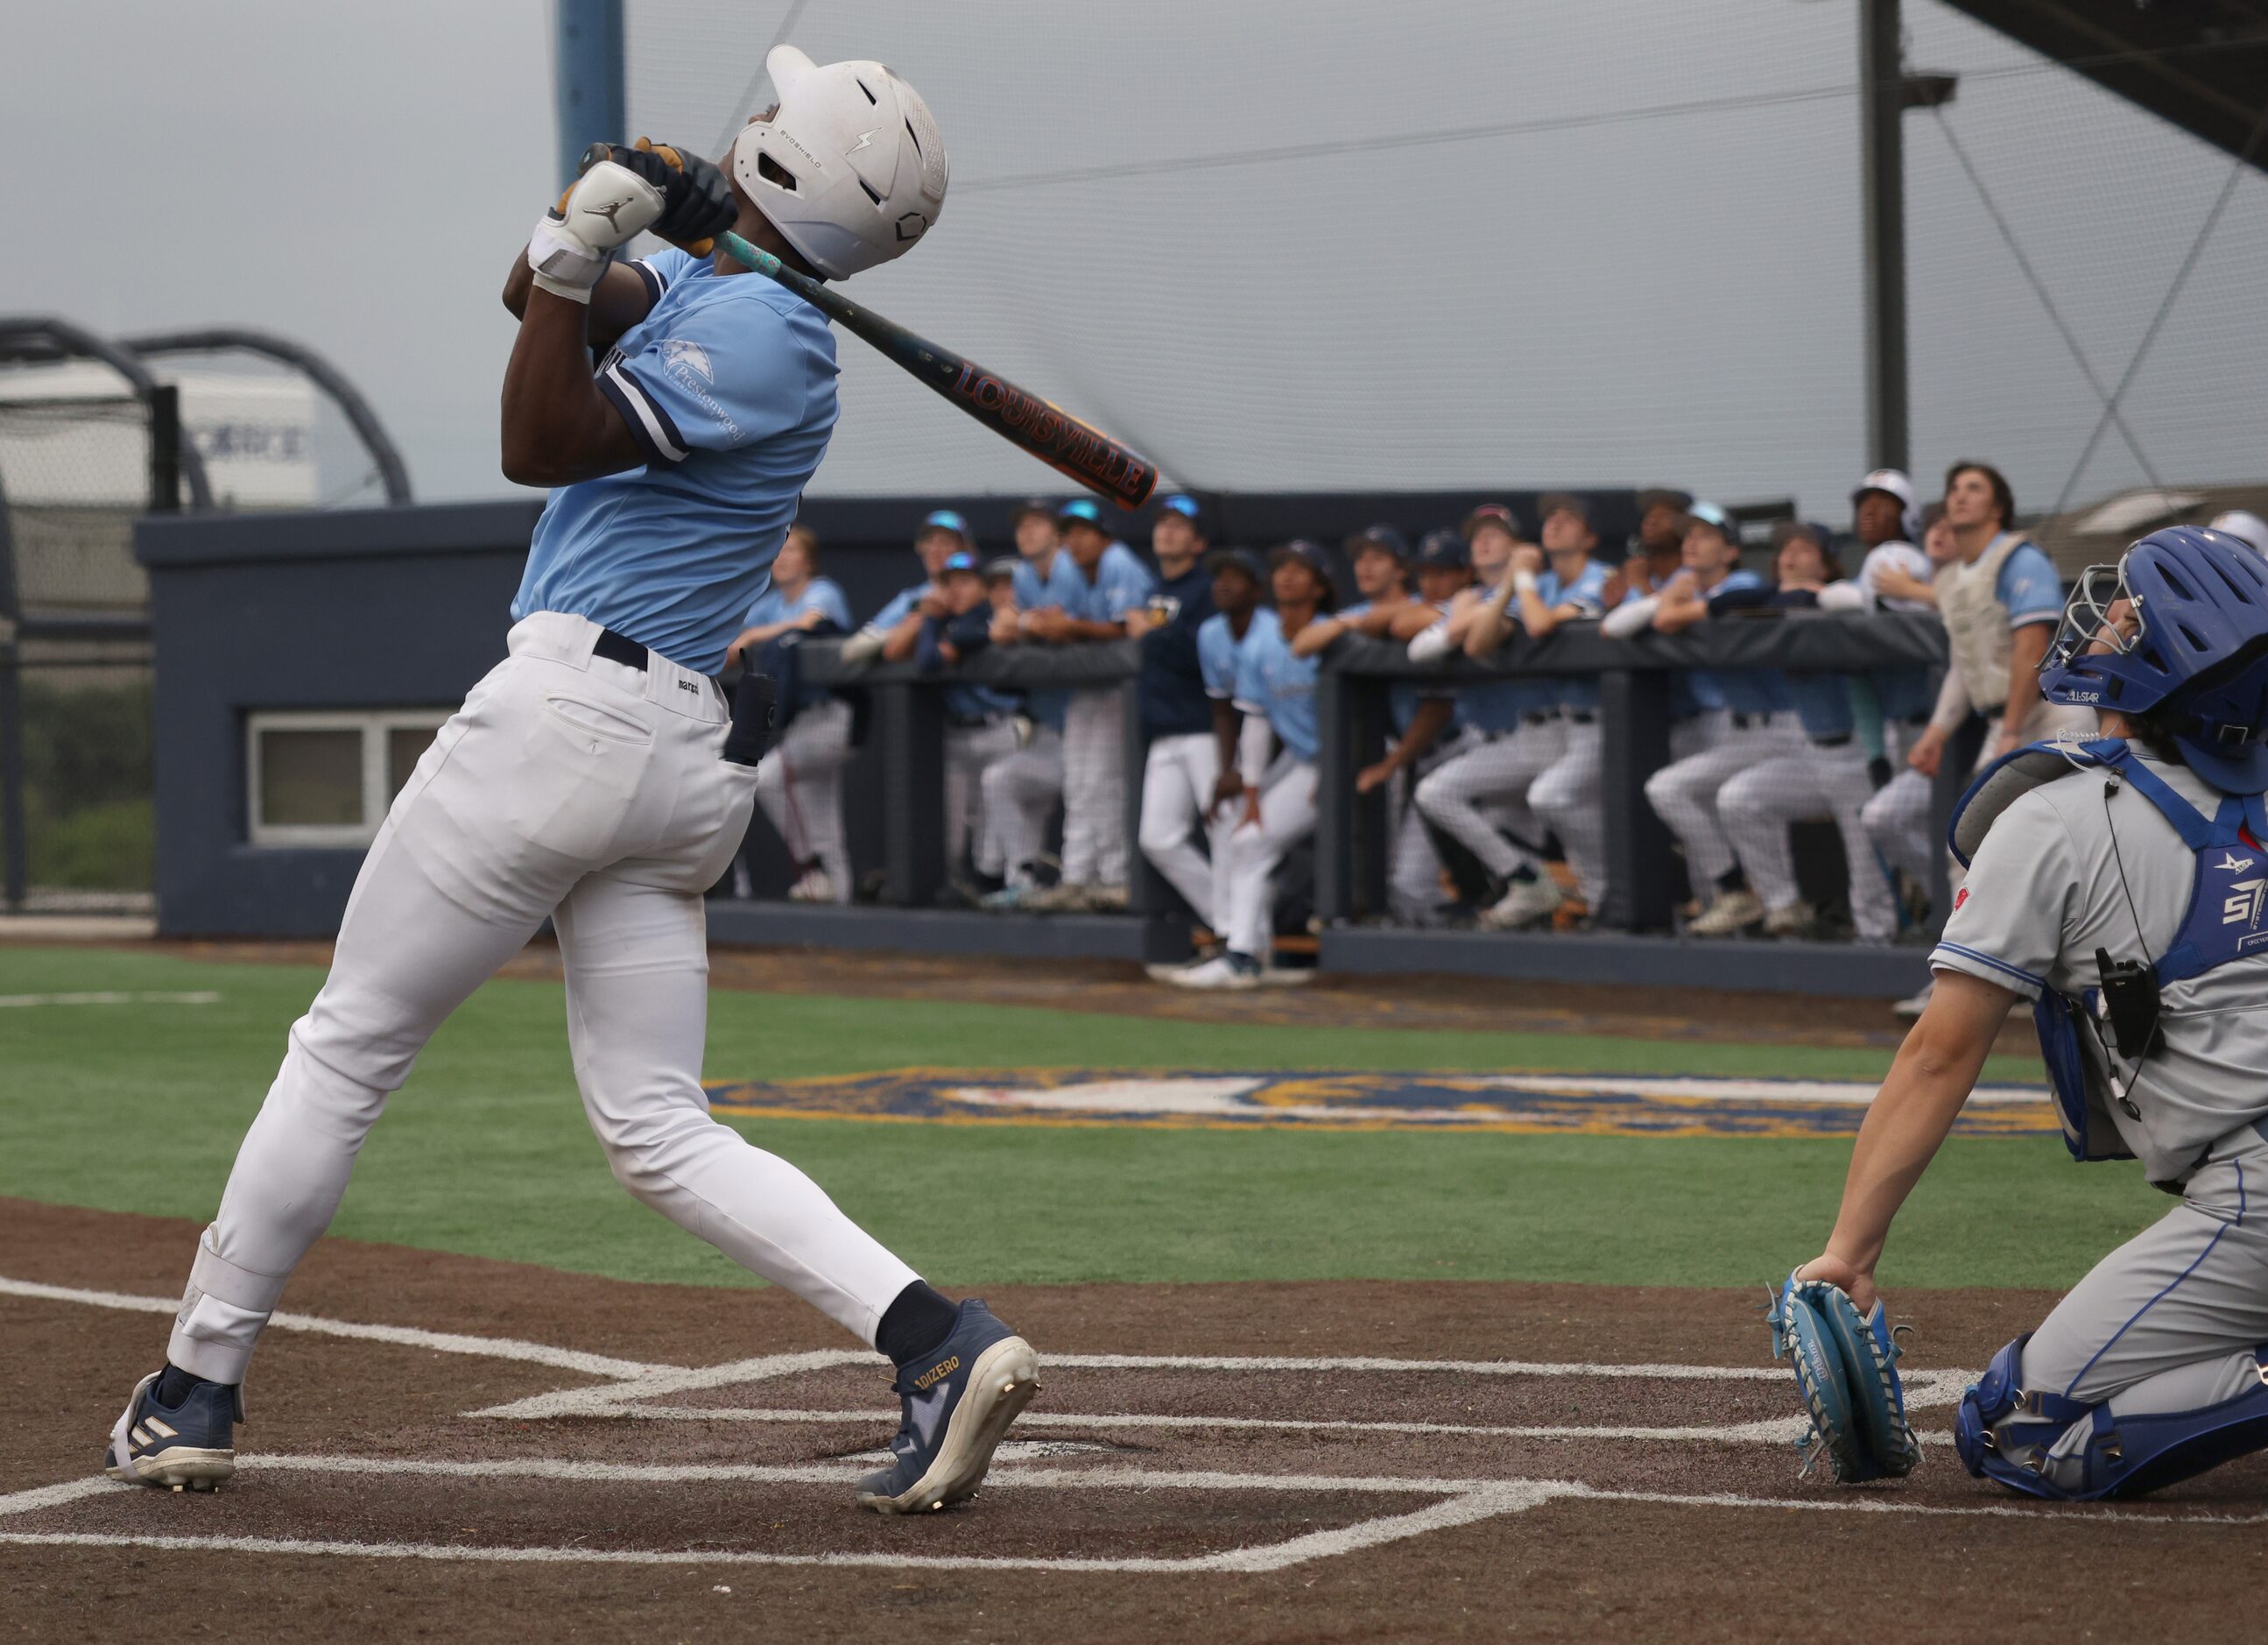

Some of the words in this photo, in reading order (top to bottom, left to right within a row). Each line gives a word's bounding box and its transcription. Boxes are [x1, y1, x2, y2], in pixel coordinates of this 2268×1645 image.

[779, 130, 821, 168] EVOSHIELD
[675, 365, 746, 441] Prestonwood
[954, 362, 1145, 496] LOUISVILLE
